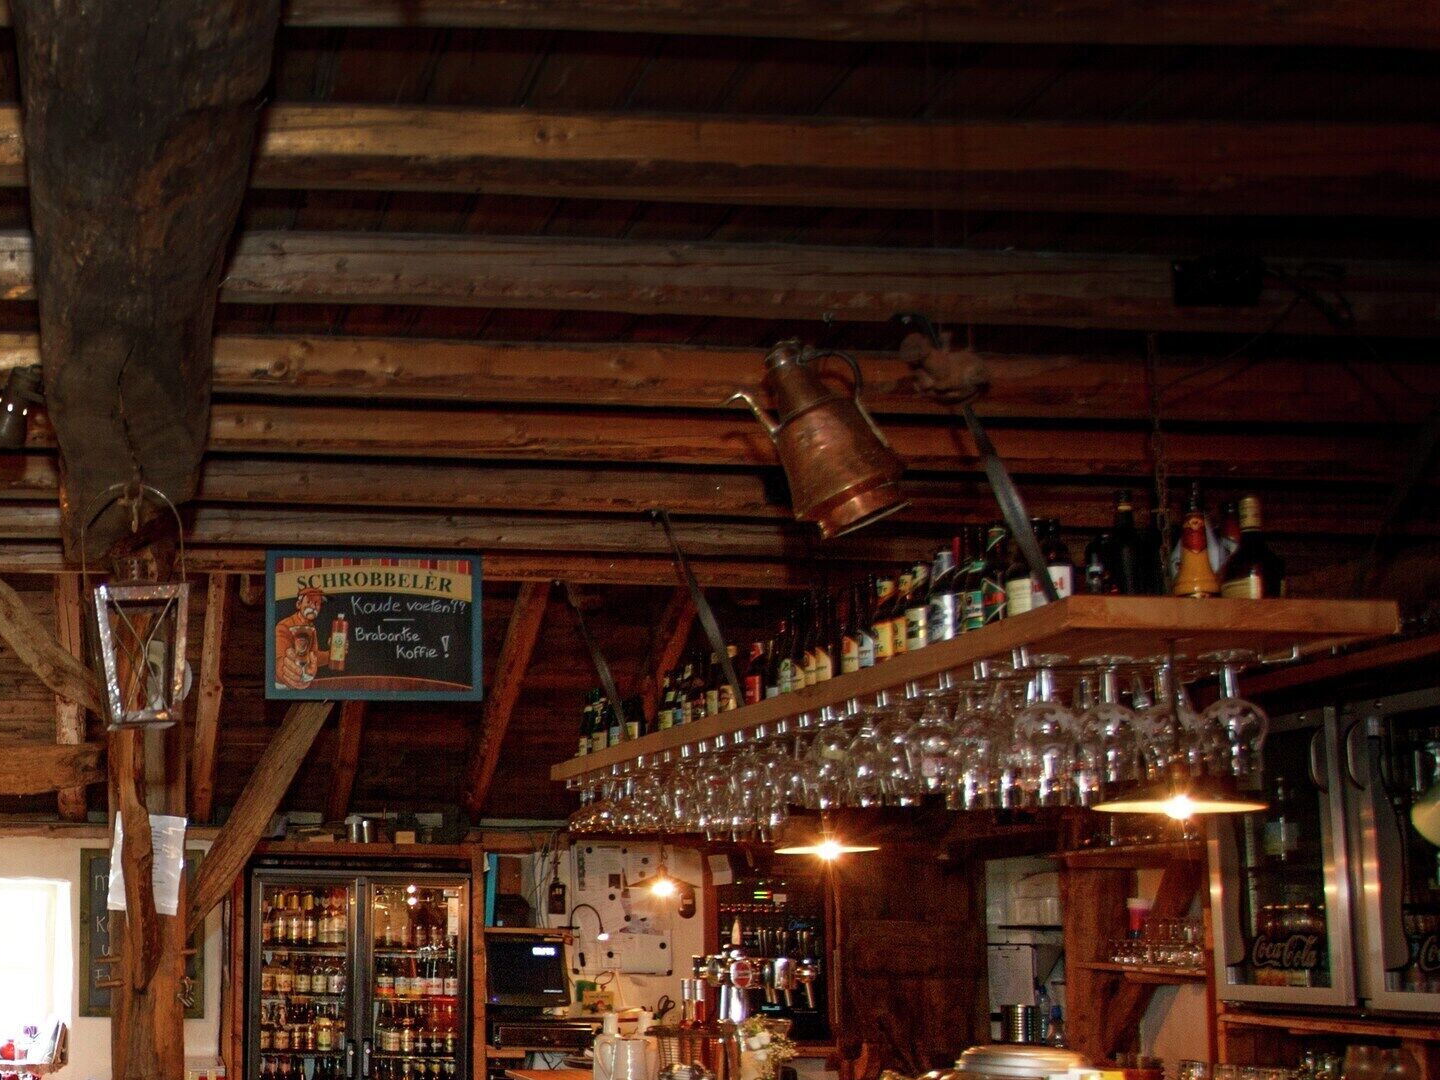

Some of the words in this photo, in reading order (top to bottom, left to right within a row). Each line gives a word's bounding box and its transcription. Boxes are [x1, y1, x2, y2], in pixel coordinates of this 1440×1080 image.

[297, 571, 452, 593] SCHROBBELÈR
[350, 595, 402, 615] Koude
[396, 644, 438, 660] Koffie
